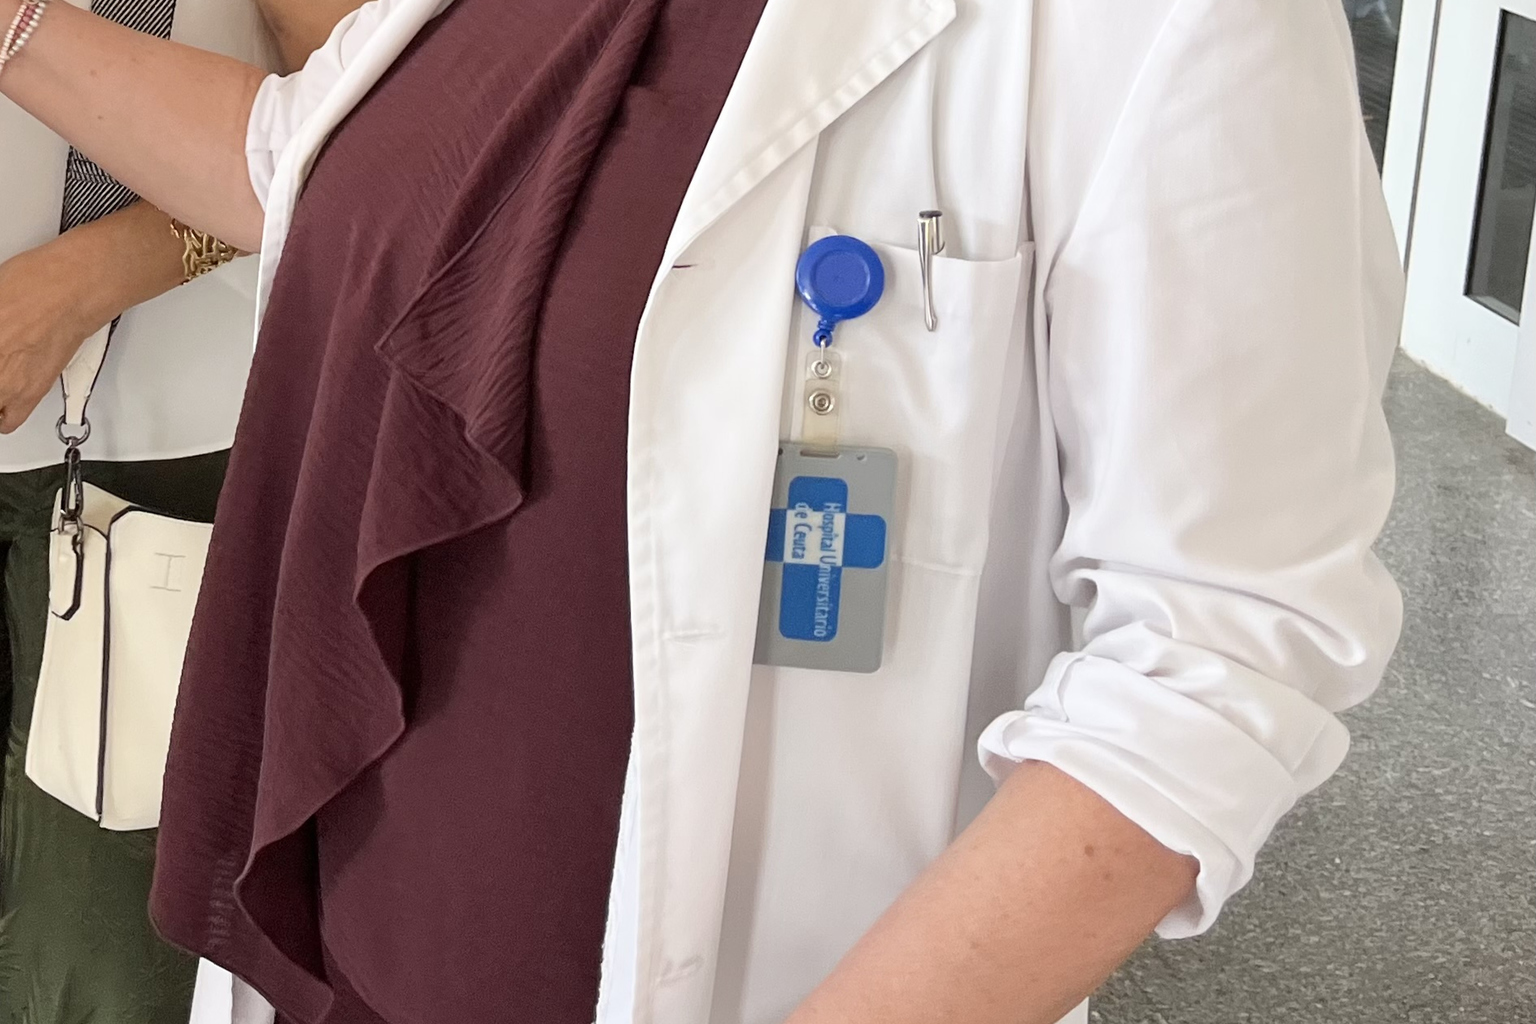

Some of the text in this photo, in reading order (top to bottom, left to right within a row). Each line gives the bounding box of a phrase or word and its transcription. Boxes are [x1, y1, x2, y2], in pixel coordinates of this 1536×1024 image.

[792, 502, 813, 559] de Ceuta
[814, 502, 841, 637] Hospital Universitario
